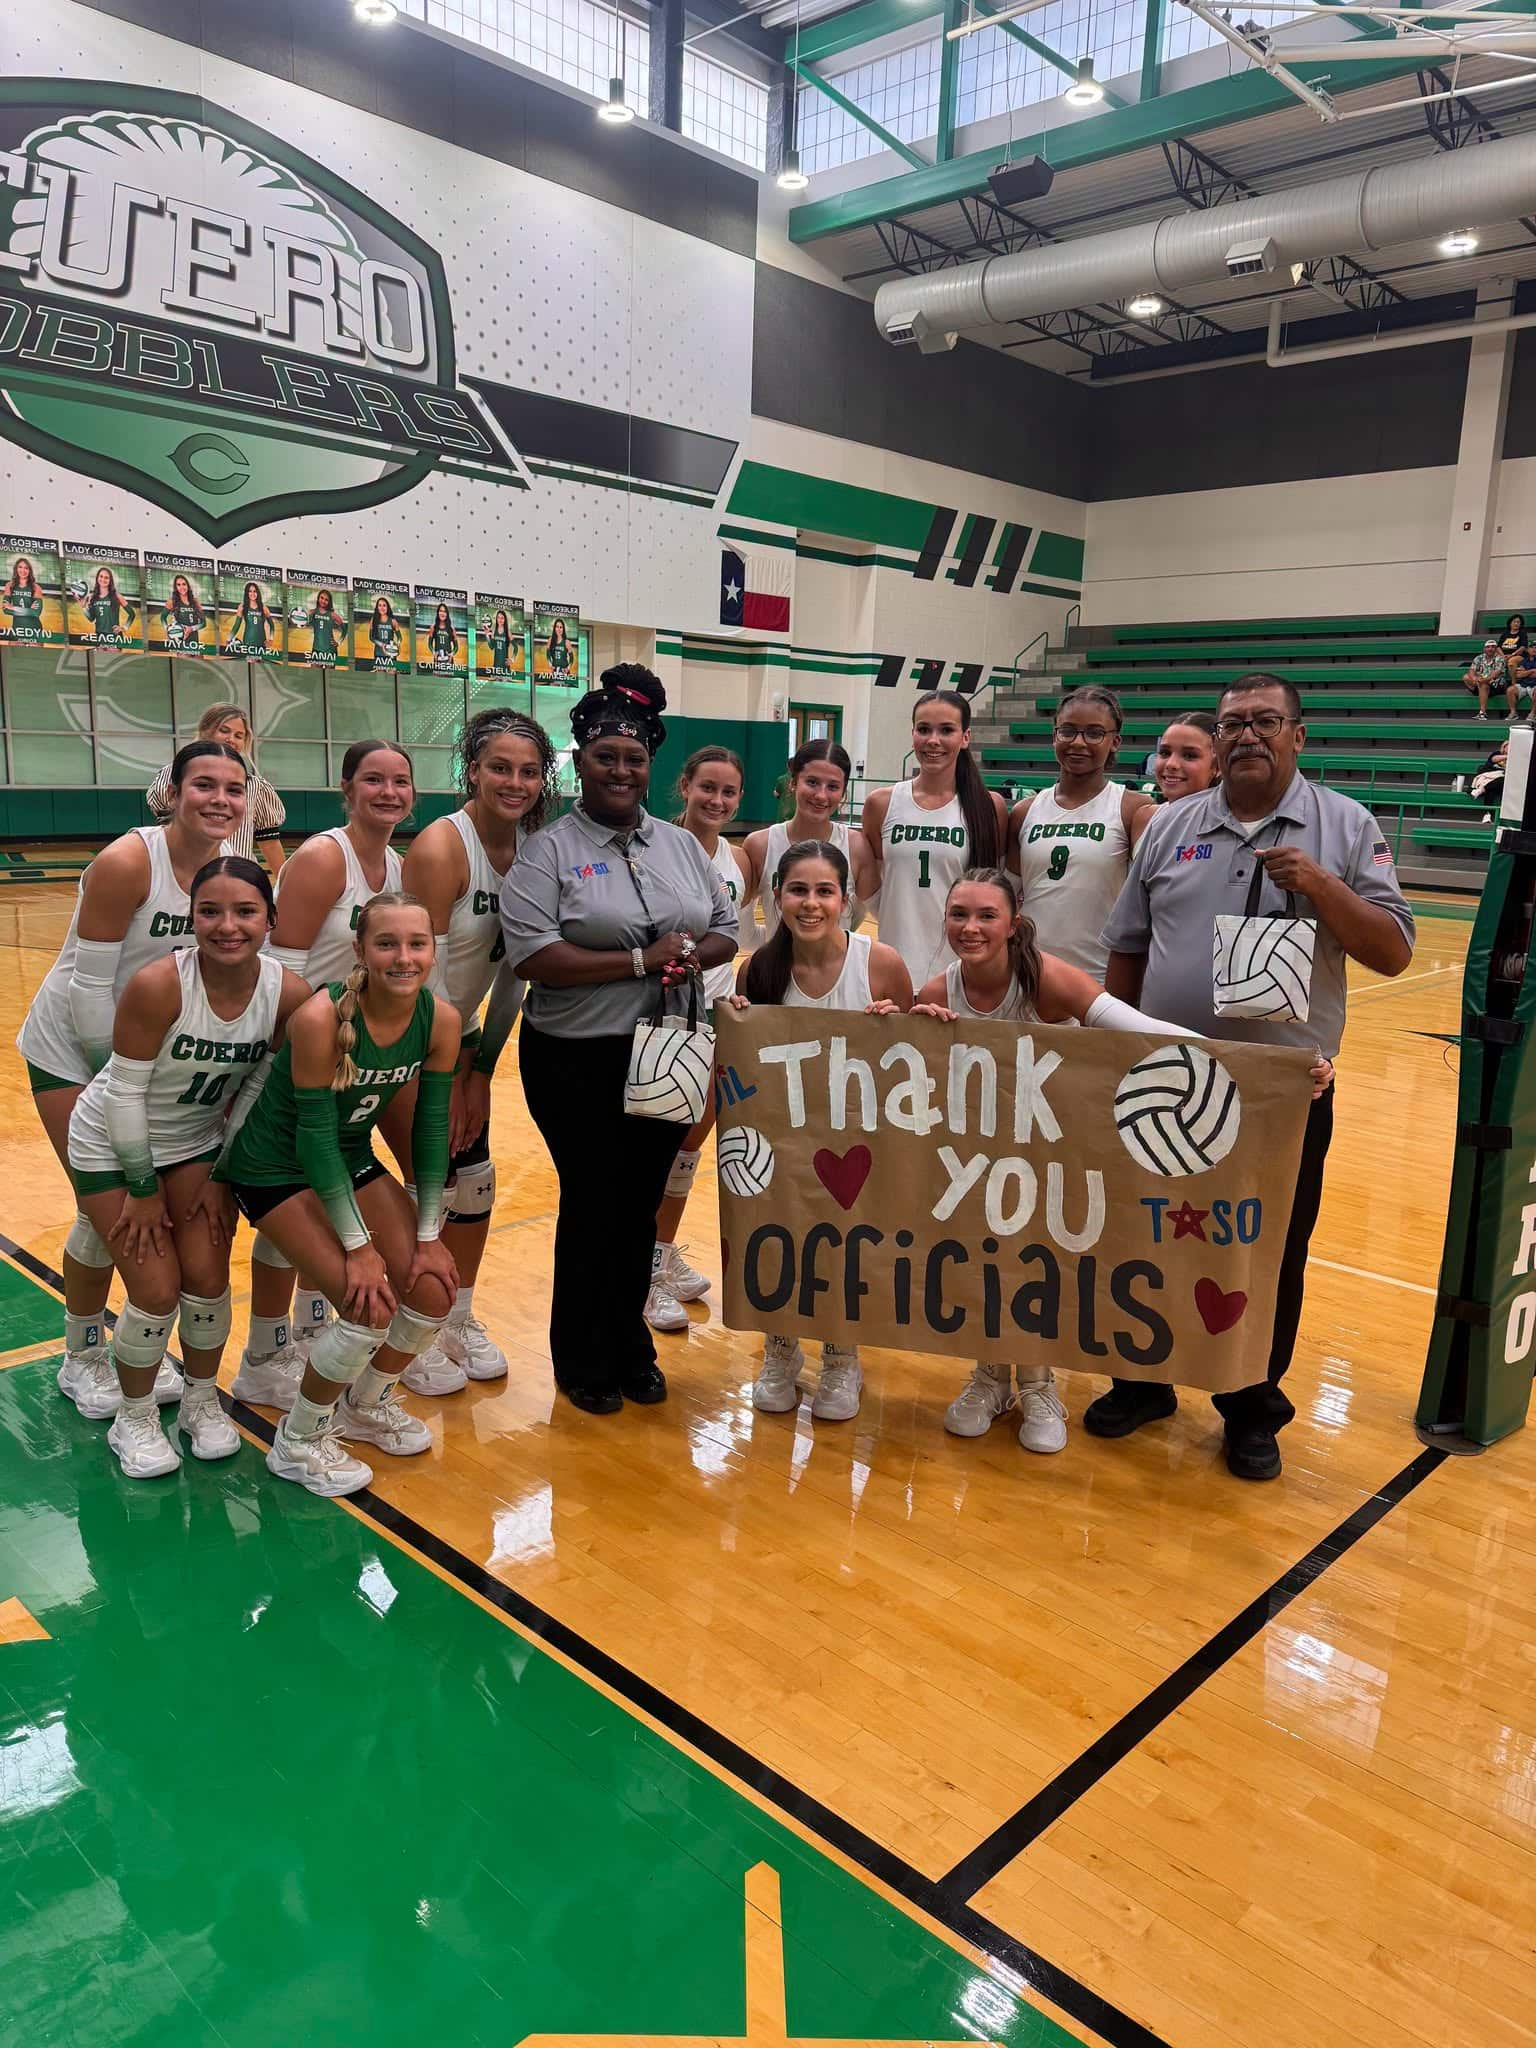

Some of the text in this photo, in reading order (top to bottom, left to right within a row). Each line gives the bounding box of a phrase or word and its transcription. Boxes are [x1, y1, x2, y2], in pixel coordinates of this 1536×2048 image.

[10, 538, 57, 550] GOBBLER
[65, 544, 137, 560] LADY GOBBLER
[146, 554, 212, 569] LADY GOBBLER
[220, 562, 280, 577] LADY GOBBLER
[288, 572, 346, 584] LADY GOBBLER
[354, 580, 408, 592] LADY GOBBLER
[416, 588, 434, 596] LADY
[436, 590, 466, 600] GOBBLER
[476, 595, 523, 607] LADY GOBBLER
[534, 603, 578, 614] LADY GOBBLER
[0, 627, 52, 638] JAEDYN
[80, 634, 133, 644] REAGAN
[164, 640, 206, 650] TAYLOR
[304, 650, 336, 660] SANAI
[375, 657, 394, 666] AVA
[419, 660, 468, 672] CATHERINE
[485, 666, 517, 676] STELLA
[890, 824, 965, 848] CUERO
[1028, 822, 1106, 844] CUERO
[918, 850, 931, 888] 1
[1047, 846, 1070, 880] 9
[171, 1033, 270, 1064] CUERO
[176, 1071, 231, 1106] 10
[758, 1035, 1064, 1144] Thank
[346, 1094, 380, 1124] 2
